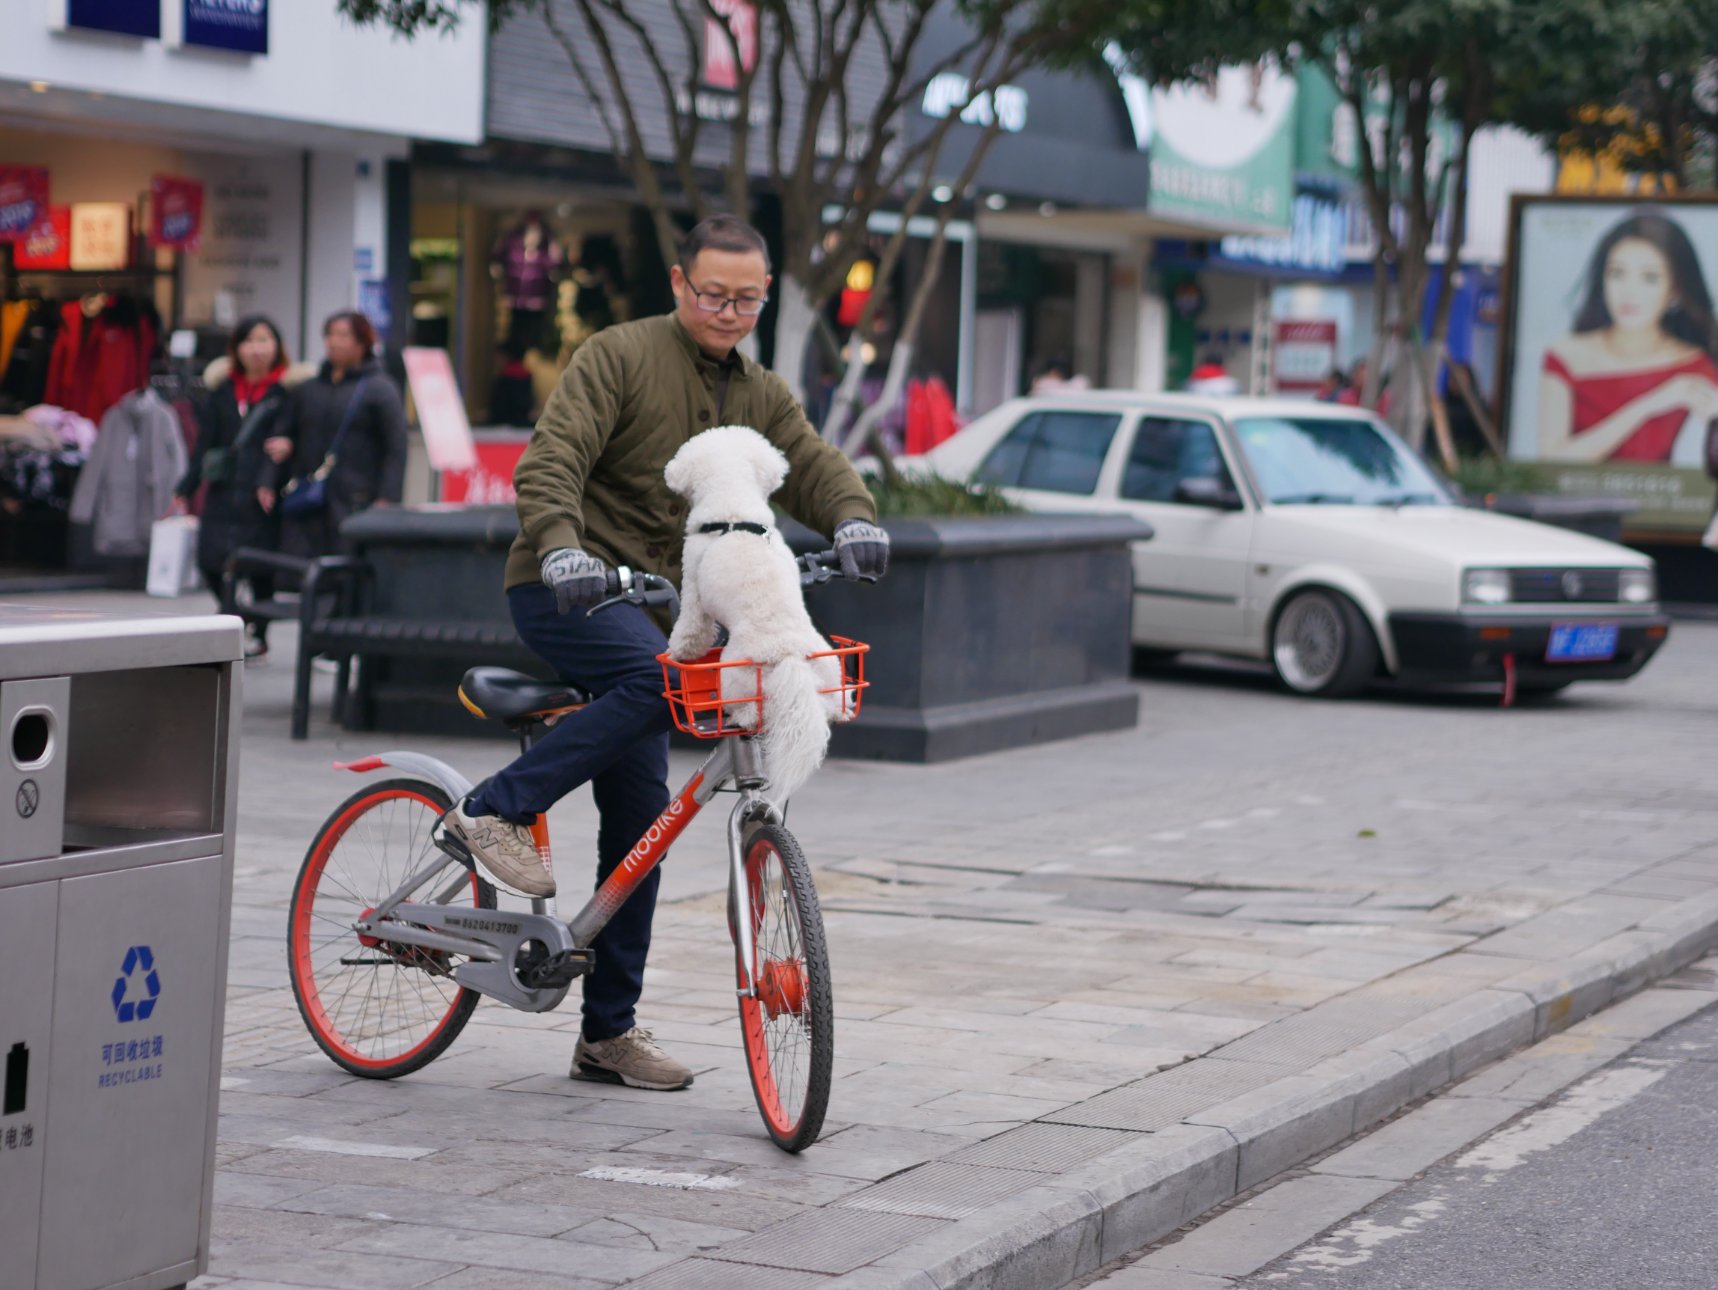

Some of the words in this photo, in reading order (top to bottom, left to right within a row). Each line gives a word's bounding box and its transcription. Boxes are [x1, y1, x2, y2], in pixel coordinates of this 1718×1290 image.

[101, 1035, 163, 1066] 可回收垃圾
[98, 1064, 162, 1088] RECYCLABLE
[0, 1124, 34, 1150] 电池
